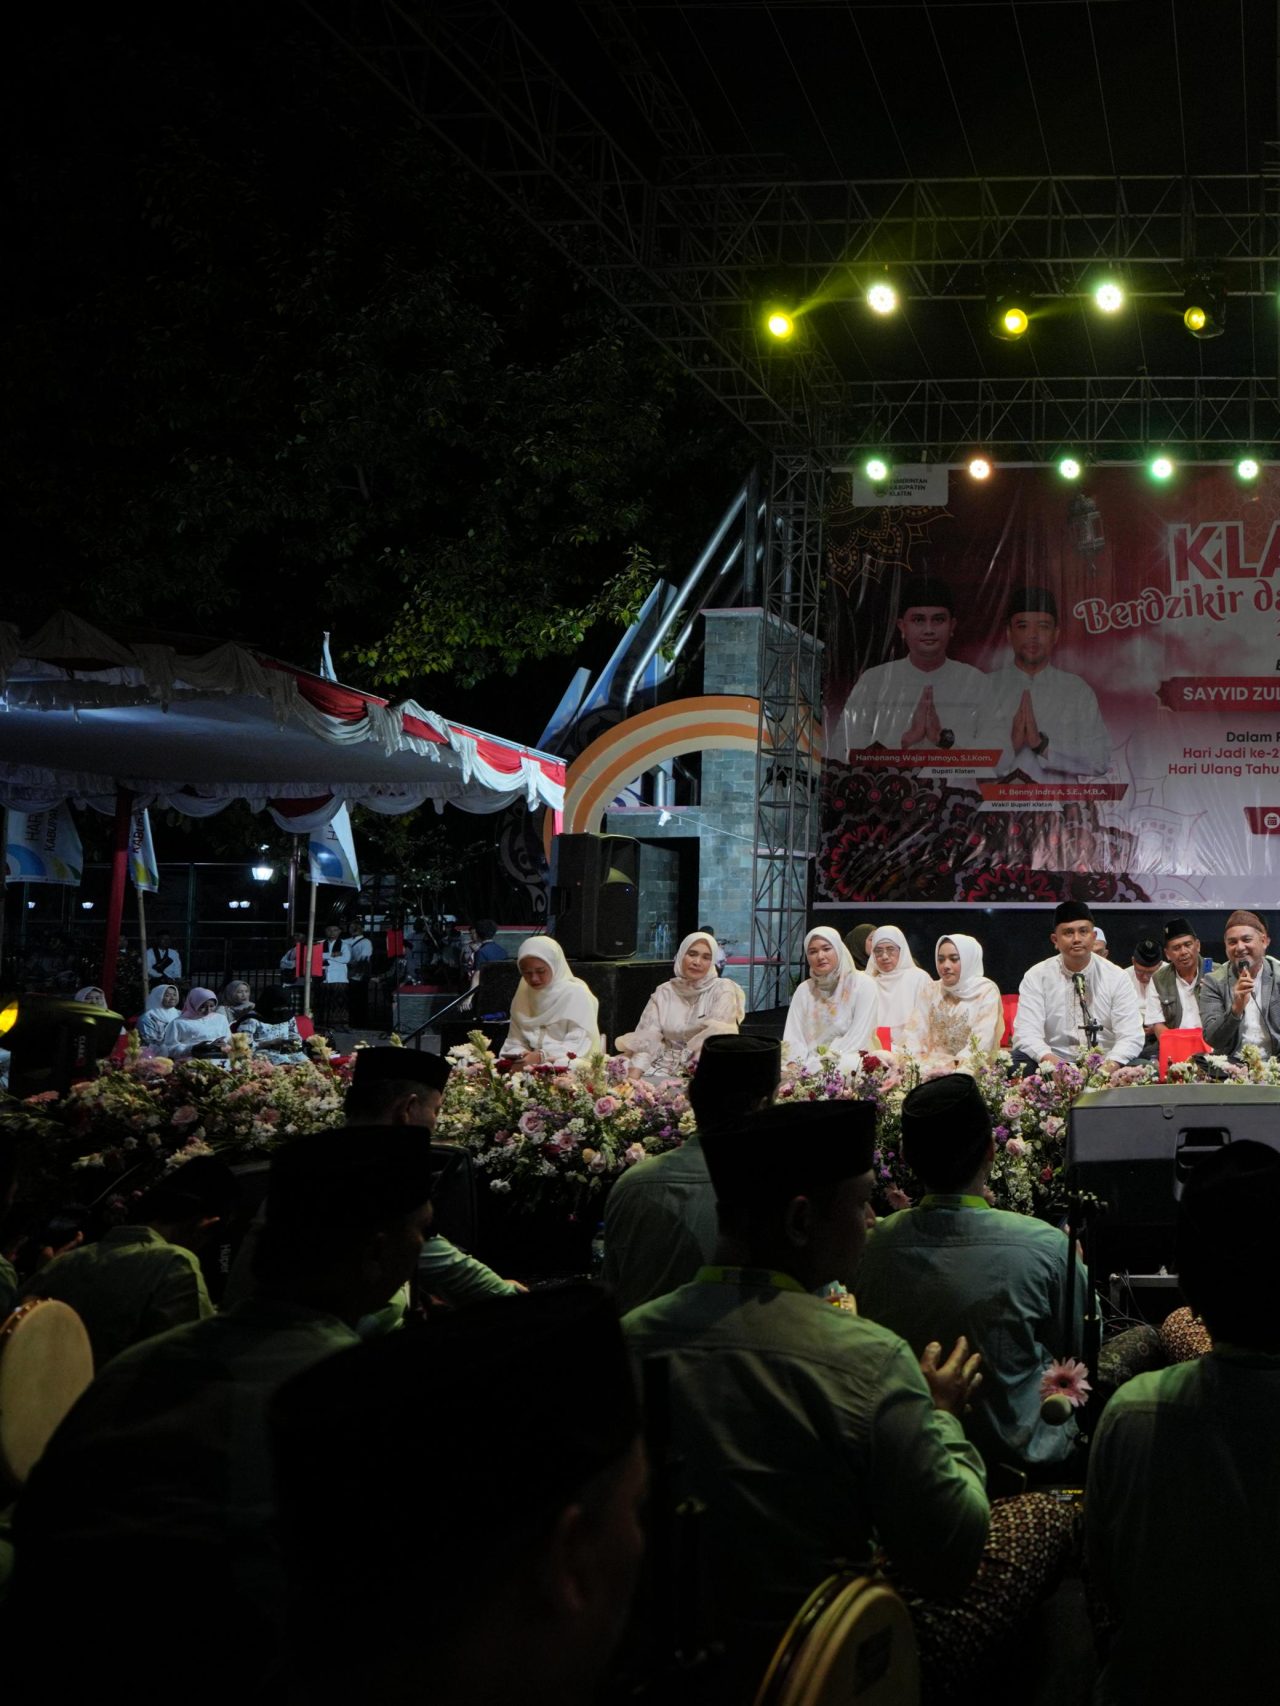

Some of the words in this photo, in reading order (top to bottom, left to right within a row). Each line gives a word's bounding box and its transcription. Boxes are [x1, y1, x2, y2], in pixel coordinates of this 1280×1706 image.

[1074, 583, 1244, 633] Berdzikir
[1183, 686, 1248, 701] SAYYID
[1226, 731, 1272, 743] Dalam
[856, 754, 900, 763] Hamenang
[1183, 748, 1212, 759] Hari
[1215, 748, 1246, 759] Jadi
[932, 768, 953, 776] Bupati
[1168, 764, 1198, 775] Hari
[1201, 764, 1242, 778] Ulang
